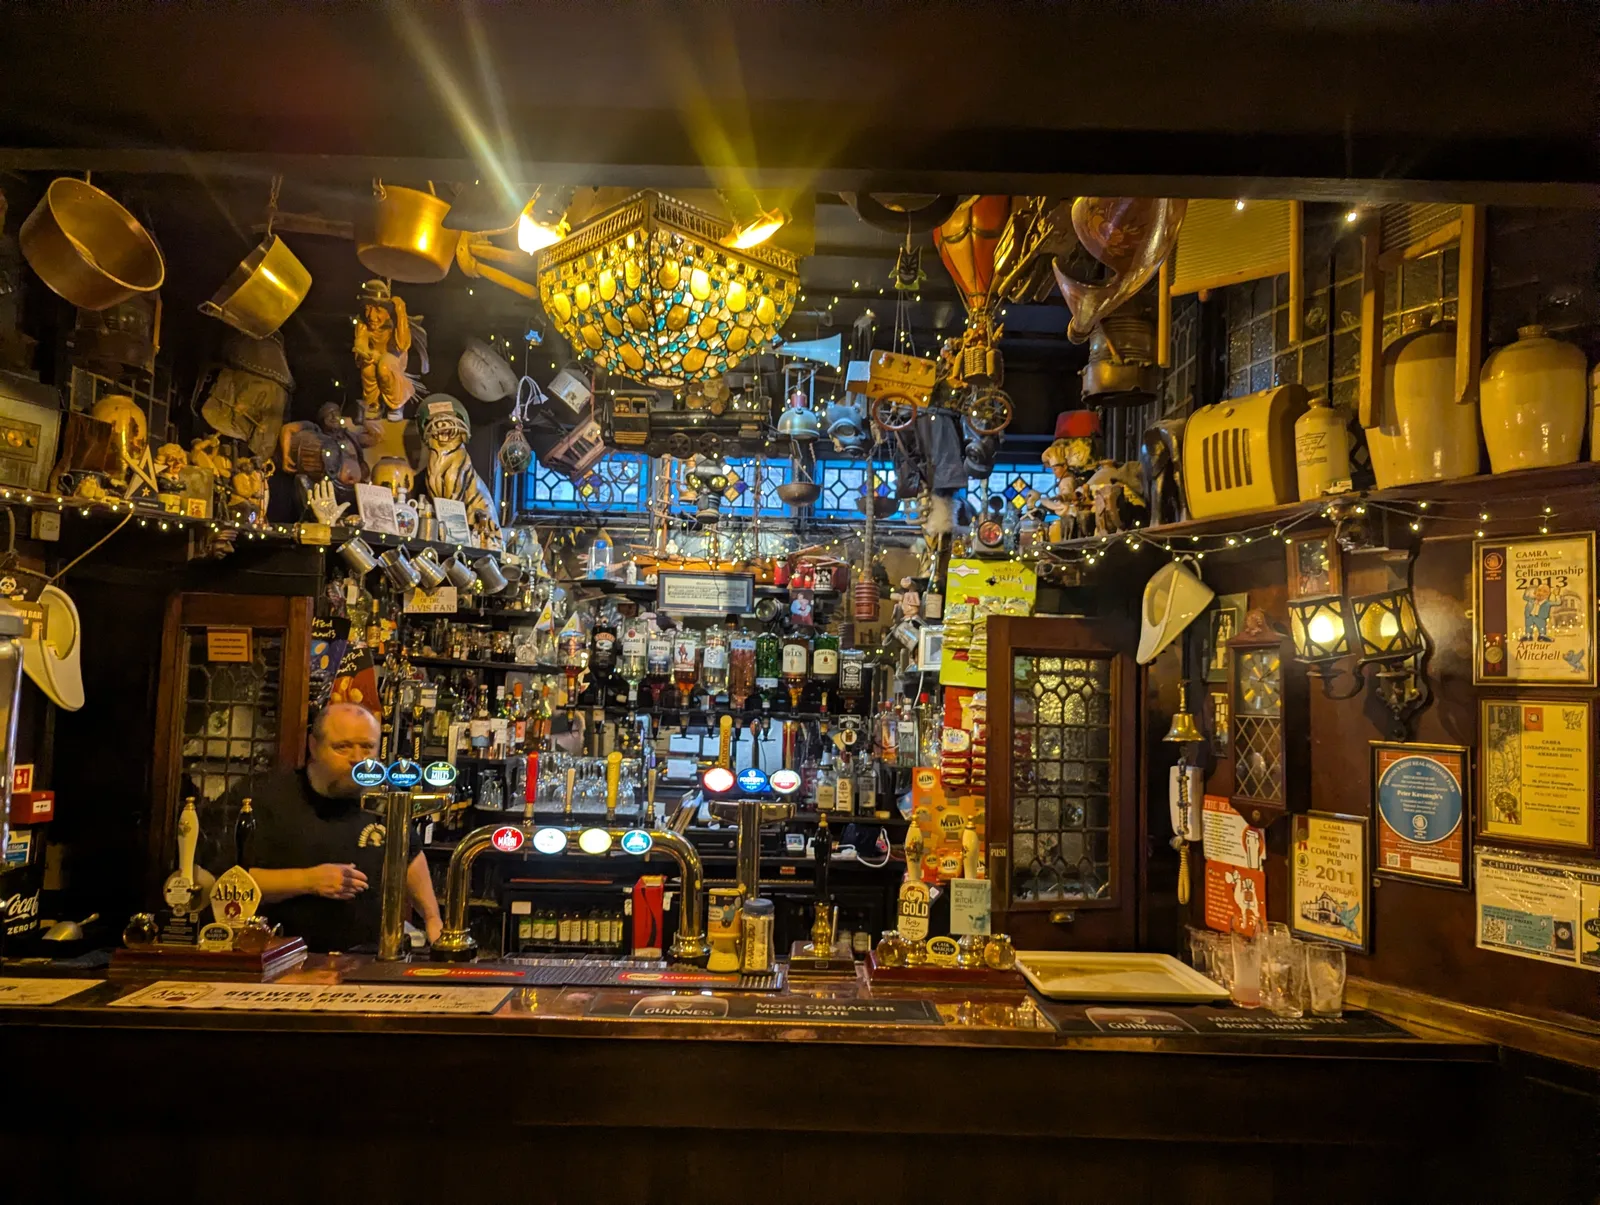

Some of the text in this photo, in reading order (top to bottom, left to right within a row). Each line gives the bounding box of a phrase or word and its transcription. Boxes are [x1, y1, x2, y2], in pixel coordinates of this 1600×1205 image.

[1515, 550, 1548, 559] CAMRA
[1515, 566, 1584, 577] Cellarmanship
[1516, 576, 1568, 590] 2013
[1516, 642, 1551, 650] Arthur
[1515, 650, 1560, 661] Mitchell
[1310, 846, 1360, 861] COMMUNITY
[1326, 857, 1342, 867] PUB
[1315, 865, 1354, 886] 2011
[212, 885, 254, 902] Abbot
[902, 901, 928, 917] GOLD
[7, 924, 29, 935] ZERO
[644, 1008, 715, 1017] GUINNESS
[805, 1004, 896, 1012] CHARACTER
[1108, 1022, 1184, 1032] GUINNESS
